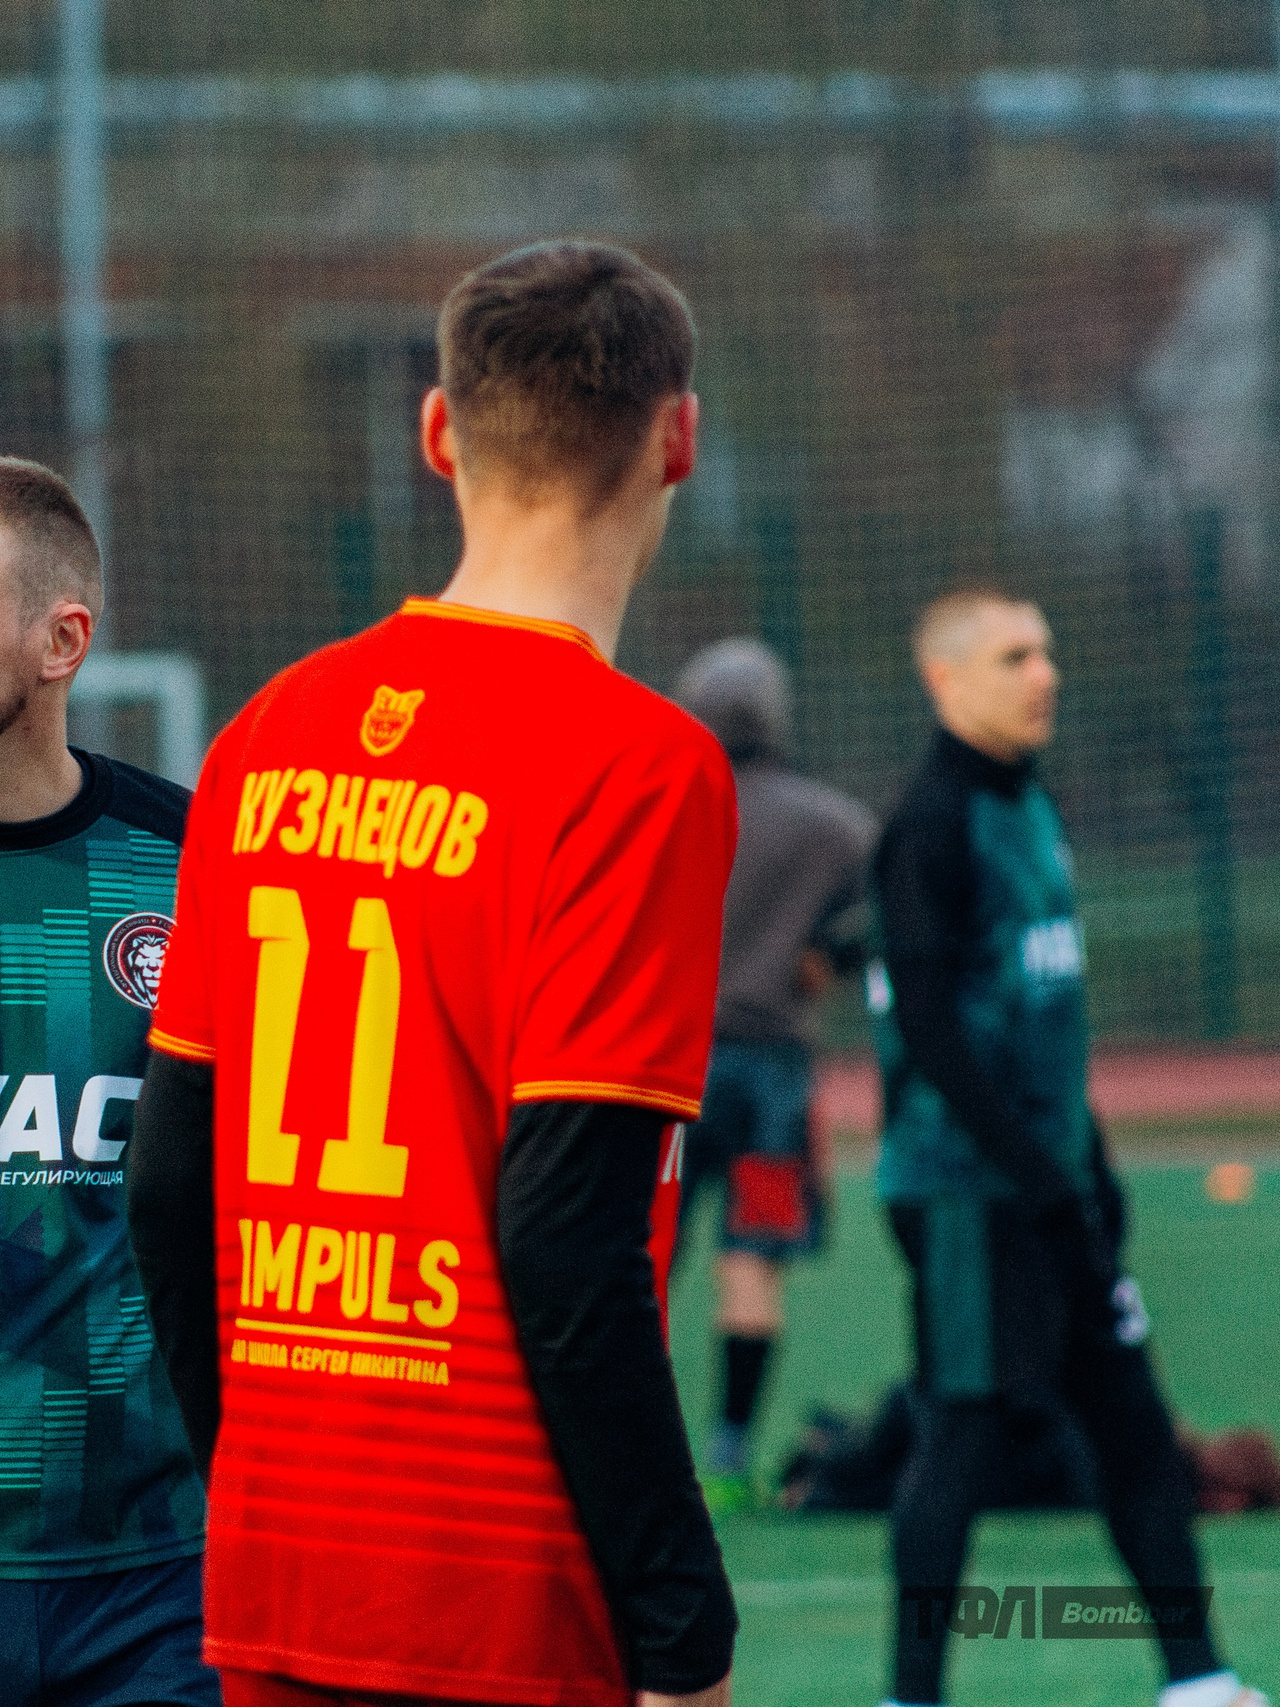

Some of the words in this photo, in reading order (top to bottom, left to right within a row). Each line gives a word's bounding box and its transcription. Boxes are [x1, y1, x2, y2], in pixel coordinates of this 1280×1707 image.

[232, 768, 489, 879] КУЗНЕЦОВ
[247, 885, 410, 1198] 11
[238, 1218, 461, 1328] IMPULS
